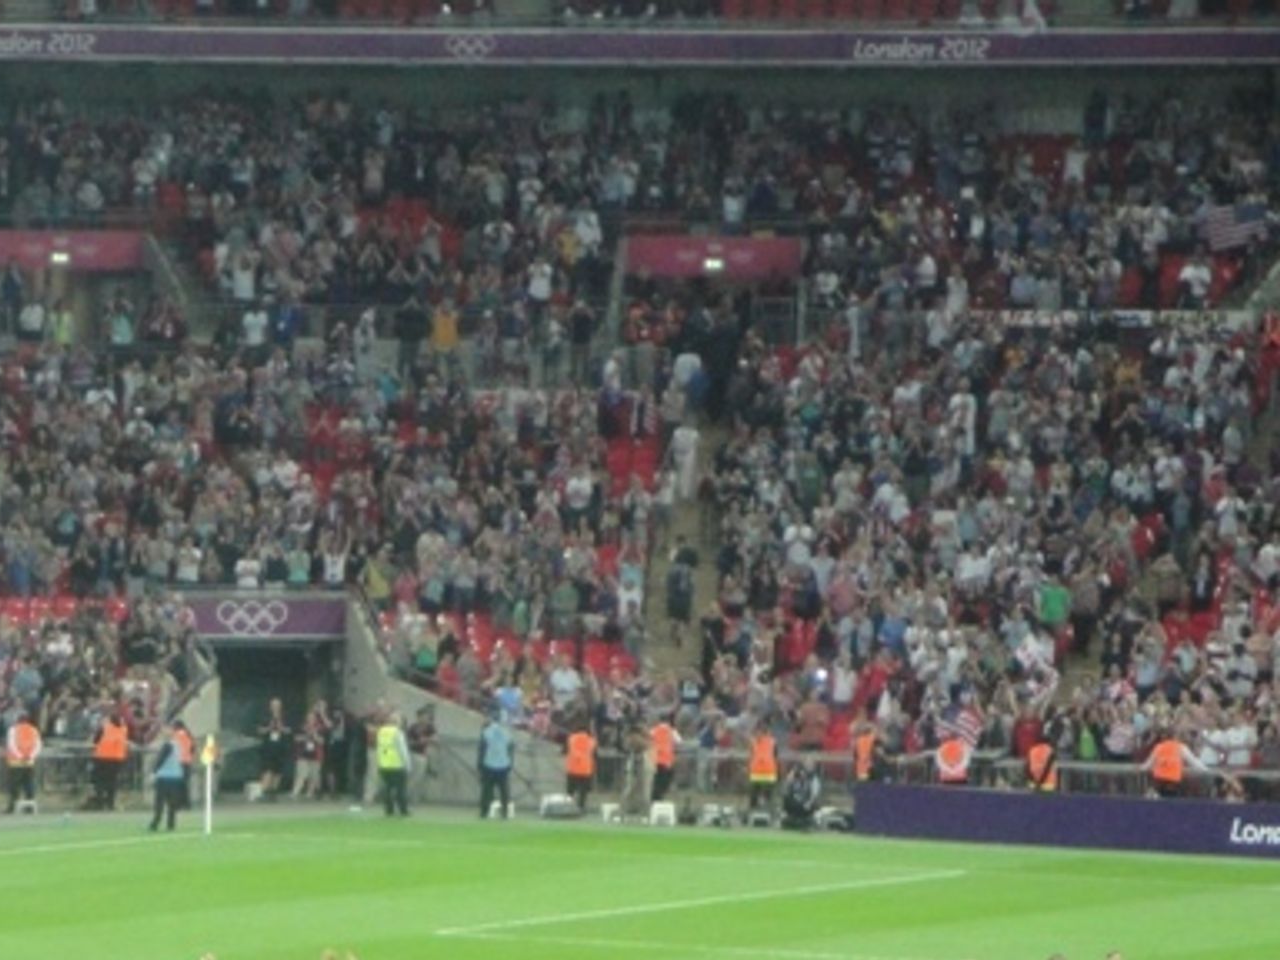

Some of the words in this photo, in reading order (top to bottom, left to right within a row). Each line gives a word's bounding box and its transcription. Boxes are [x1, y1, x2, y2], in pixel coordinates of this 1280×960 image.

[46, 31, 97, 54] 2012
[853, 36, 935, 60] London
[939, 38, 991, 60] 2012
